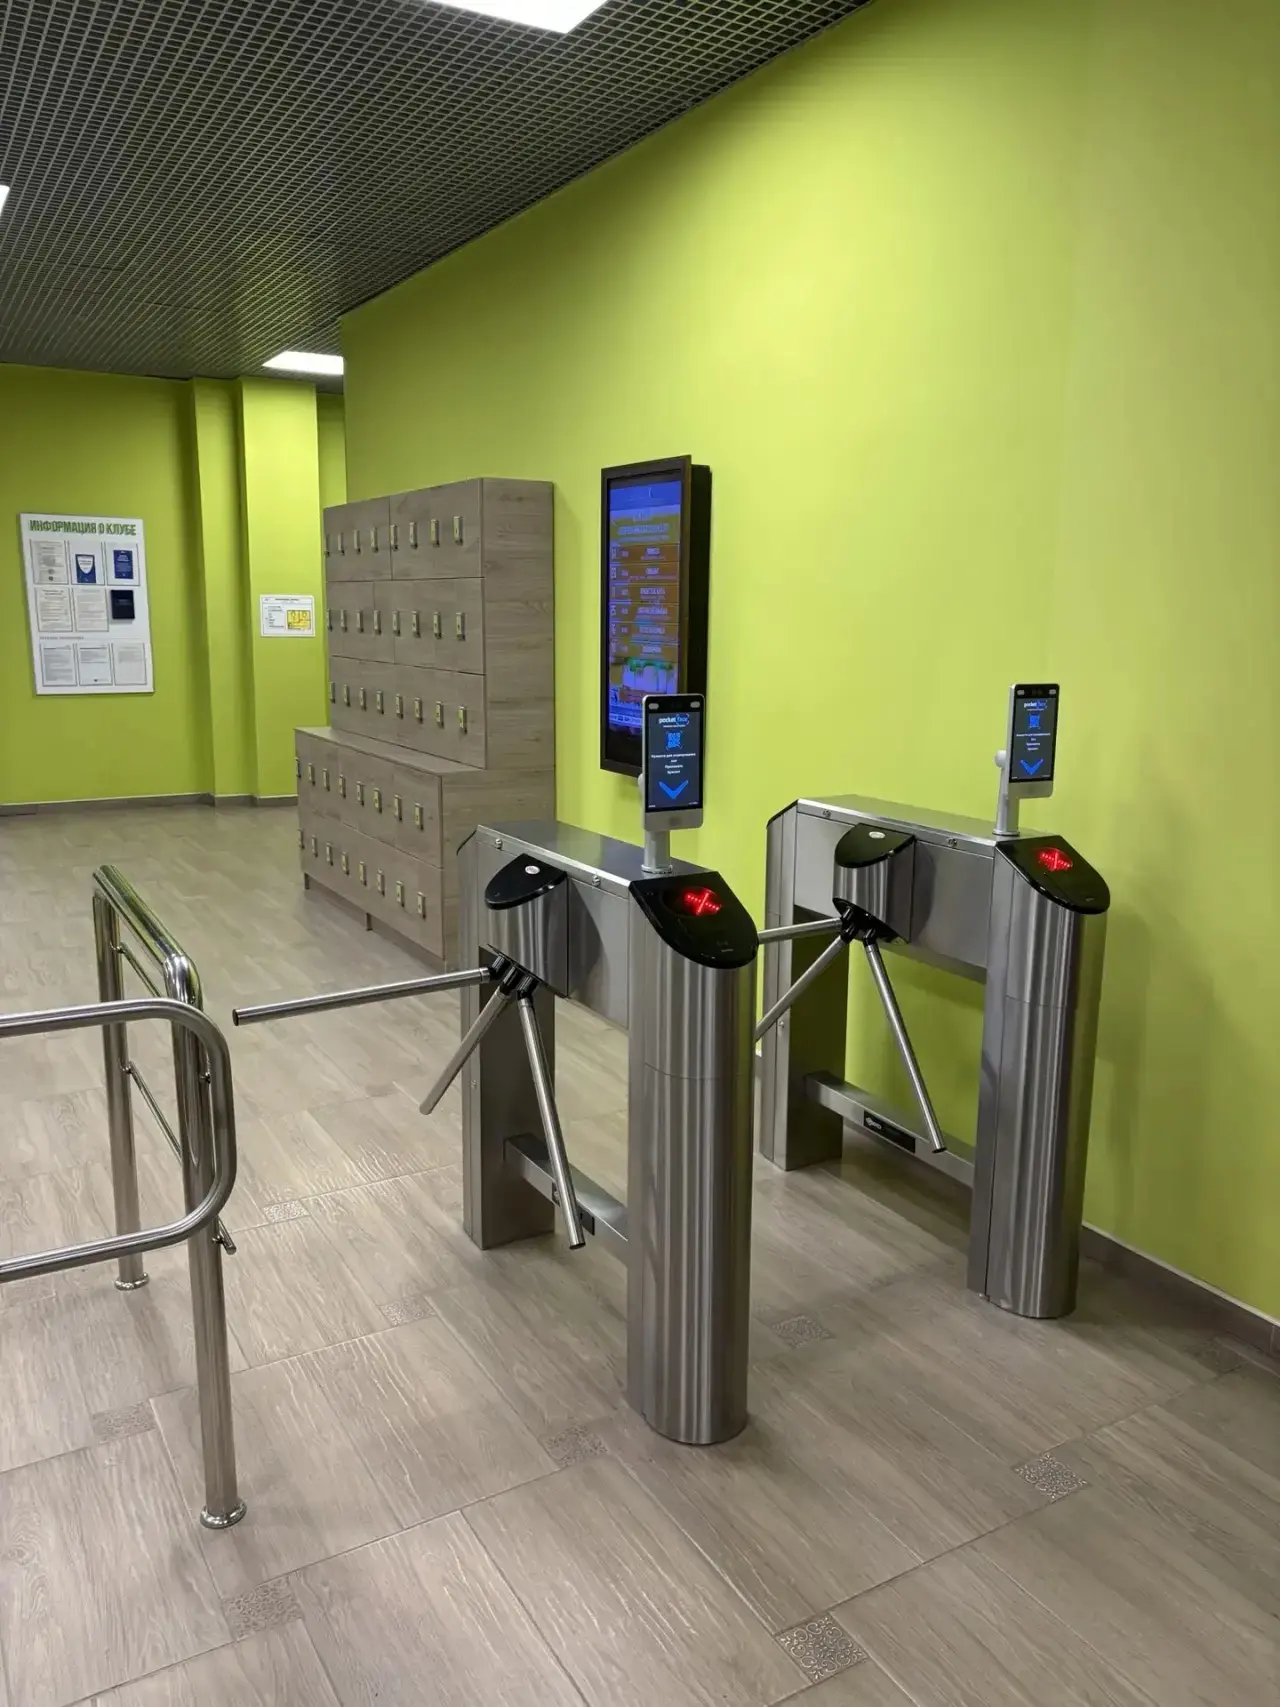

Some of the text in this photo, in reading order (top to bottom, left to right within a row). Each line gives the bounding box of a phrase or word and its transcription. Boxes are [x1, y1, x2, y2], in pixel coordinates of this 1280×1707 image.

[29, 519, 137, 536] ИНФОРМАЦИЯ О КЛУБЕ
